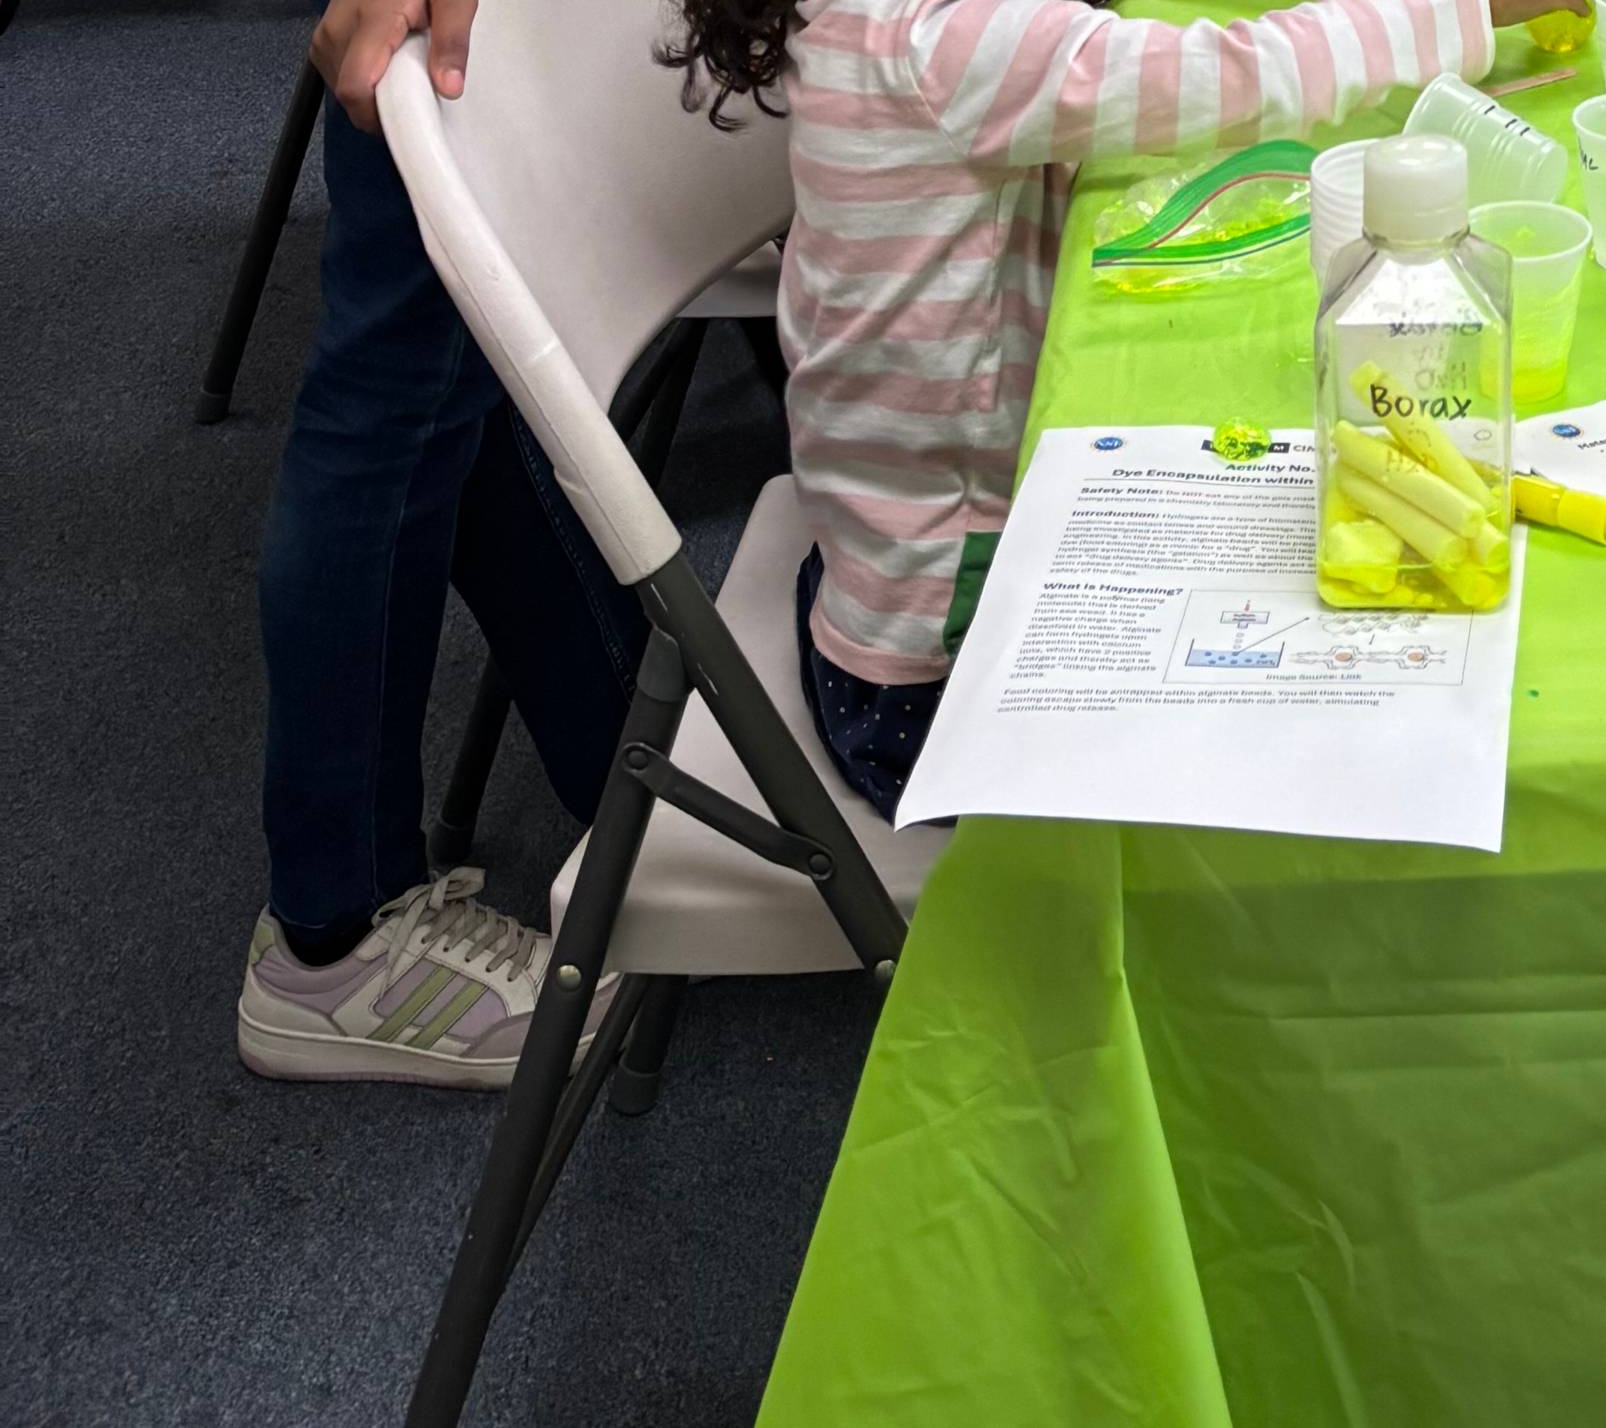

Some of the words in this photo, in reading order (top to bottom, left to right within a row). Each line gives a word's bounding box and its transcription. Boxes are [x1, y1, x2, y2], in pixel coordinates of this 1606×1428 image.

[1370, 384, 1472, 421] Borax
[1225, 463, 1286, 473] Activity
[1289, 464, 1316, 473] No.
[1112, 469, 1143, 478] Dye
[1145, 469, 1261, 484] Encapsulation
[1264, 476, 1314, 485] within
[1081, 487, 1123, 496] Safety
[1126, 487, 1163, 495] Note:
[1072, 510, 1160, 520] Introduction:
[1044, 583, 1080, 591] What
[1084, 583, 1095, 591] is
[1099, 584, 1184, 596] Happening?
